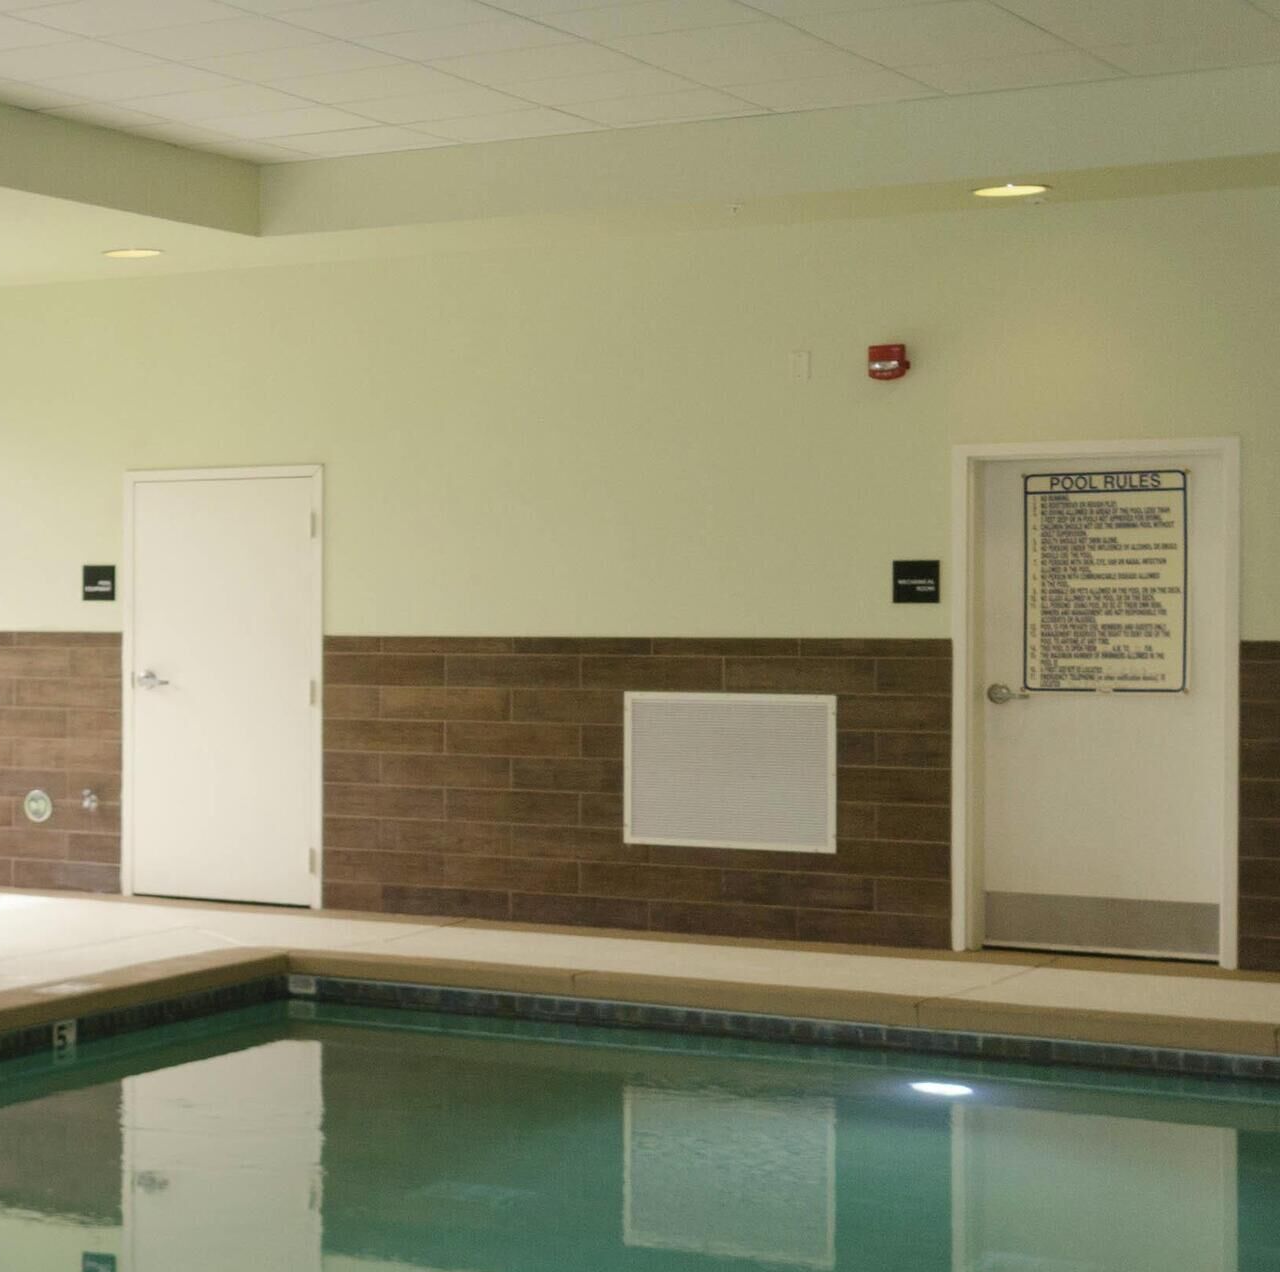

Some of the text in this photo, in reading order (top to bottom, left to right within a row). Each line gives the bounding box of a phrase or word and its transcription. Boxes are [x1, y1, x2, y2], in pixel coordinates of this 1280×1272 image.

[1050, 474, 1161, 490] POOL RULES
[58, 1025, 68, 1050] 5
